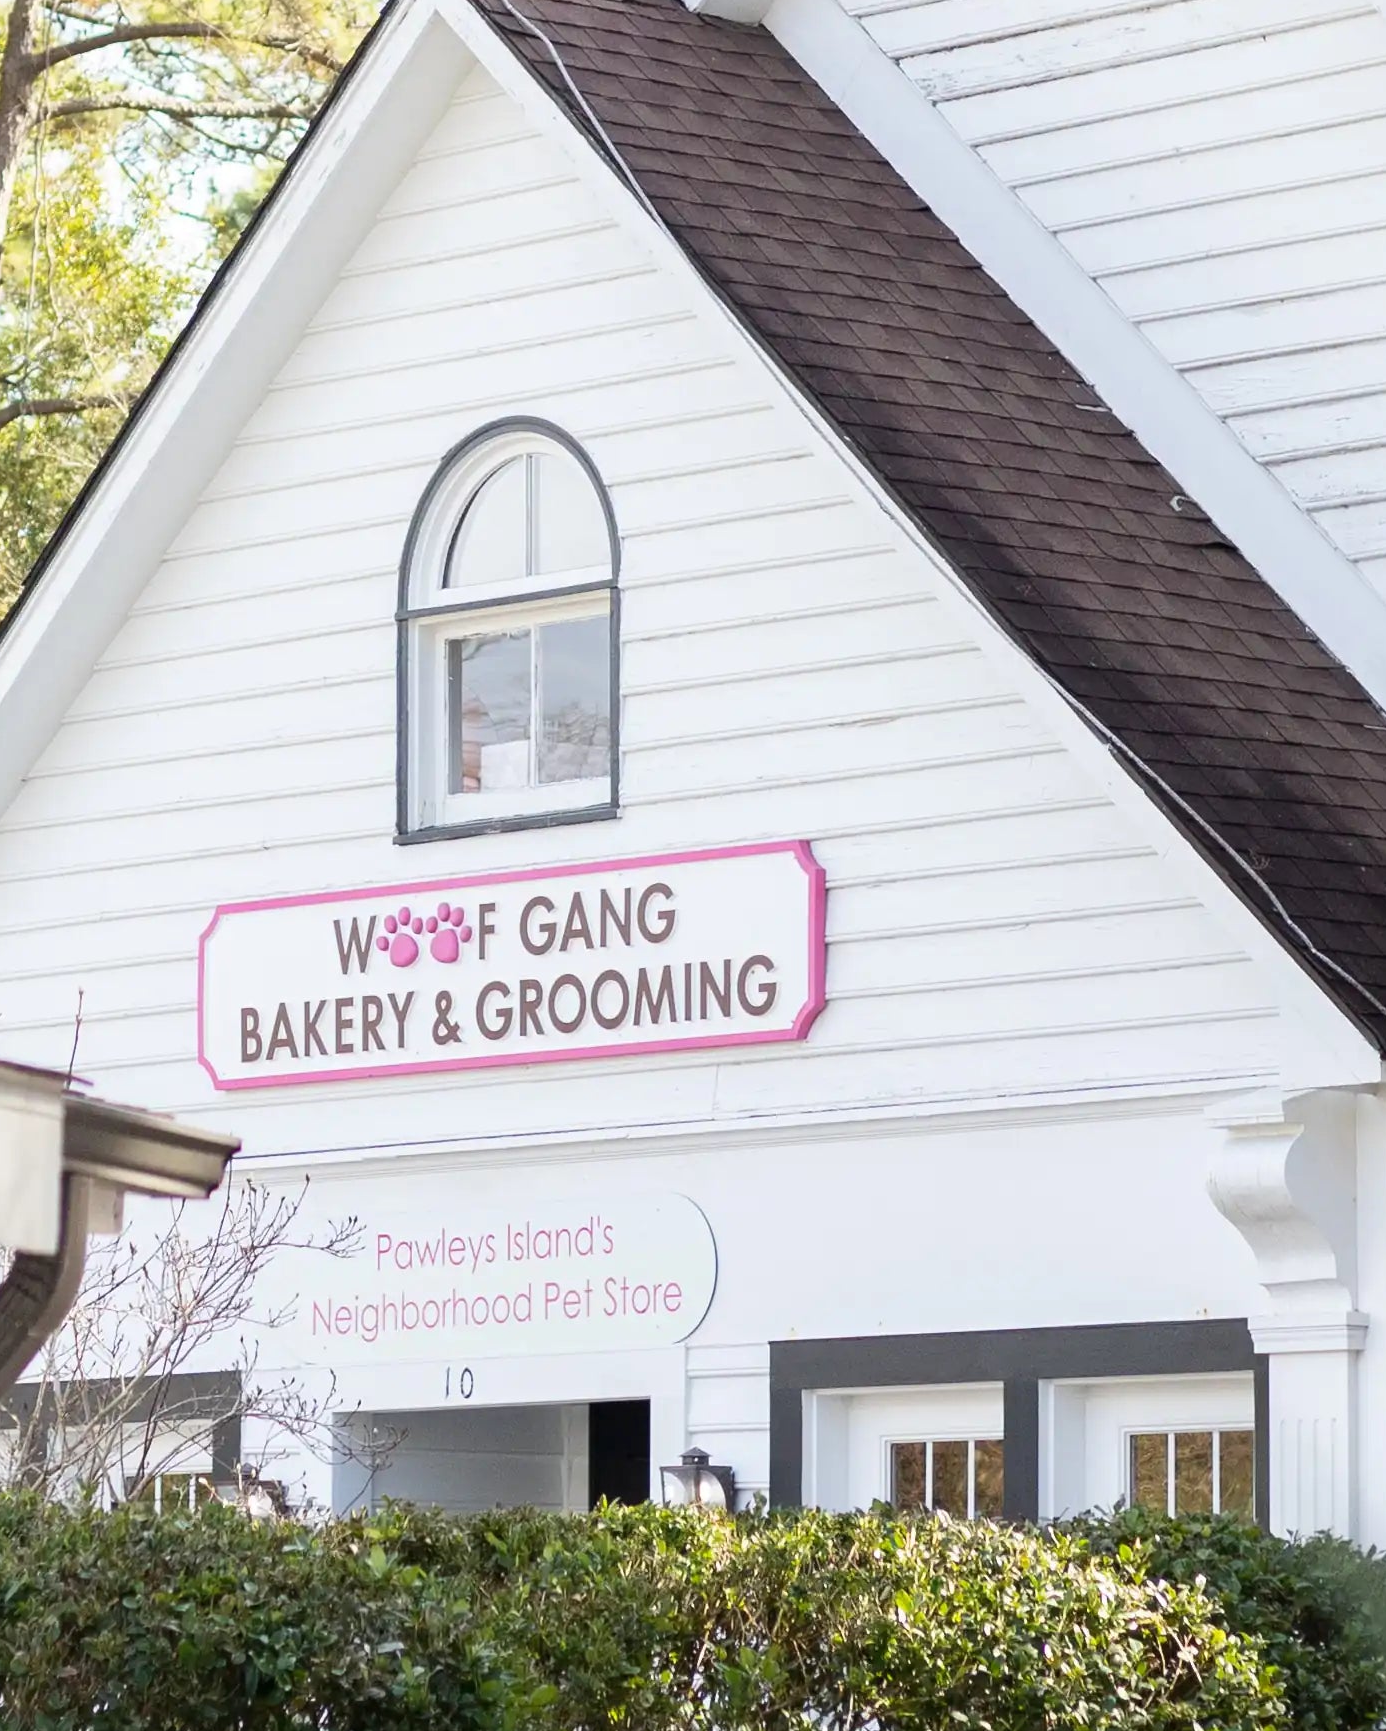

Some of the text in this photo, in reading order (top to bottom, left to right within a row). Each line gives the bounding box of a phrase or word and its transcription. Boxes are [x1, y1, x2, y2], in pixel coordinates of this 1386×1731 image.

[519, 882, 677, 957] GANG
[240, 954, 778, 1063] BAKERY & GROOMING
[376, 1215, 614, 1274] Pawleys Island's
[311, 1275, 683, 1343] Neighborhood Pet Store
[445, 1366, 475, 1400] 10
